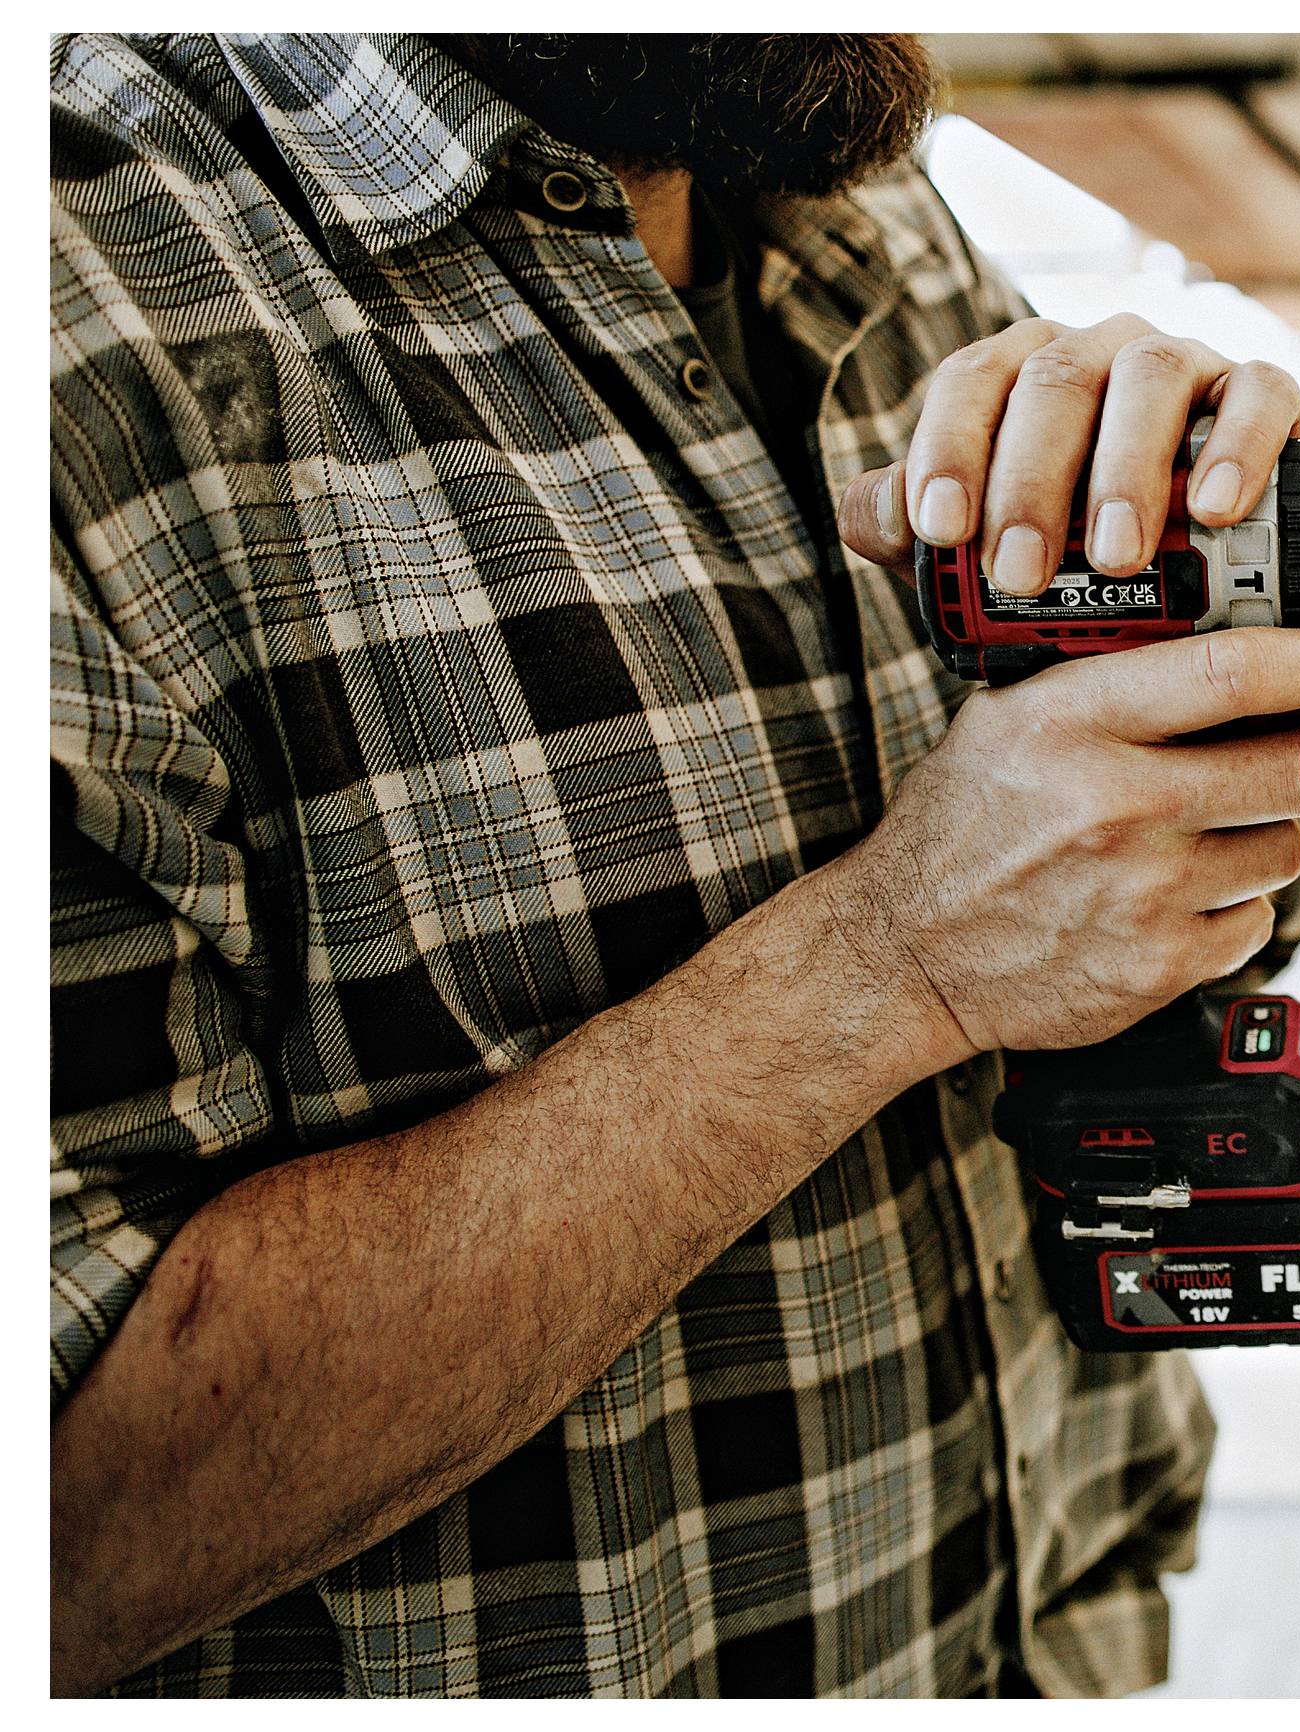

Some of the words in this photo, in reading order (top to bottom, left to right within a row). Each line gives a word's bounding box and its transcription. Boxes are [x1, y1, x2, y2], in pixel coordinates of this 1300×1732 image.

[1133, 583, 1155, 595] UK
[1134, 594, 1157, 605] CA
[1207, 1132, 1249, 1155] EC
[1178, 1287, 1233, 1301] POWER
[1189, 1306, 1230, 1323] 18V
